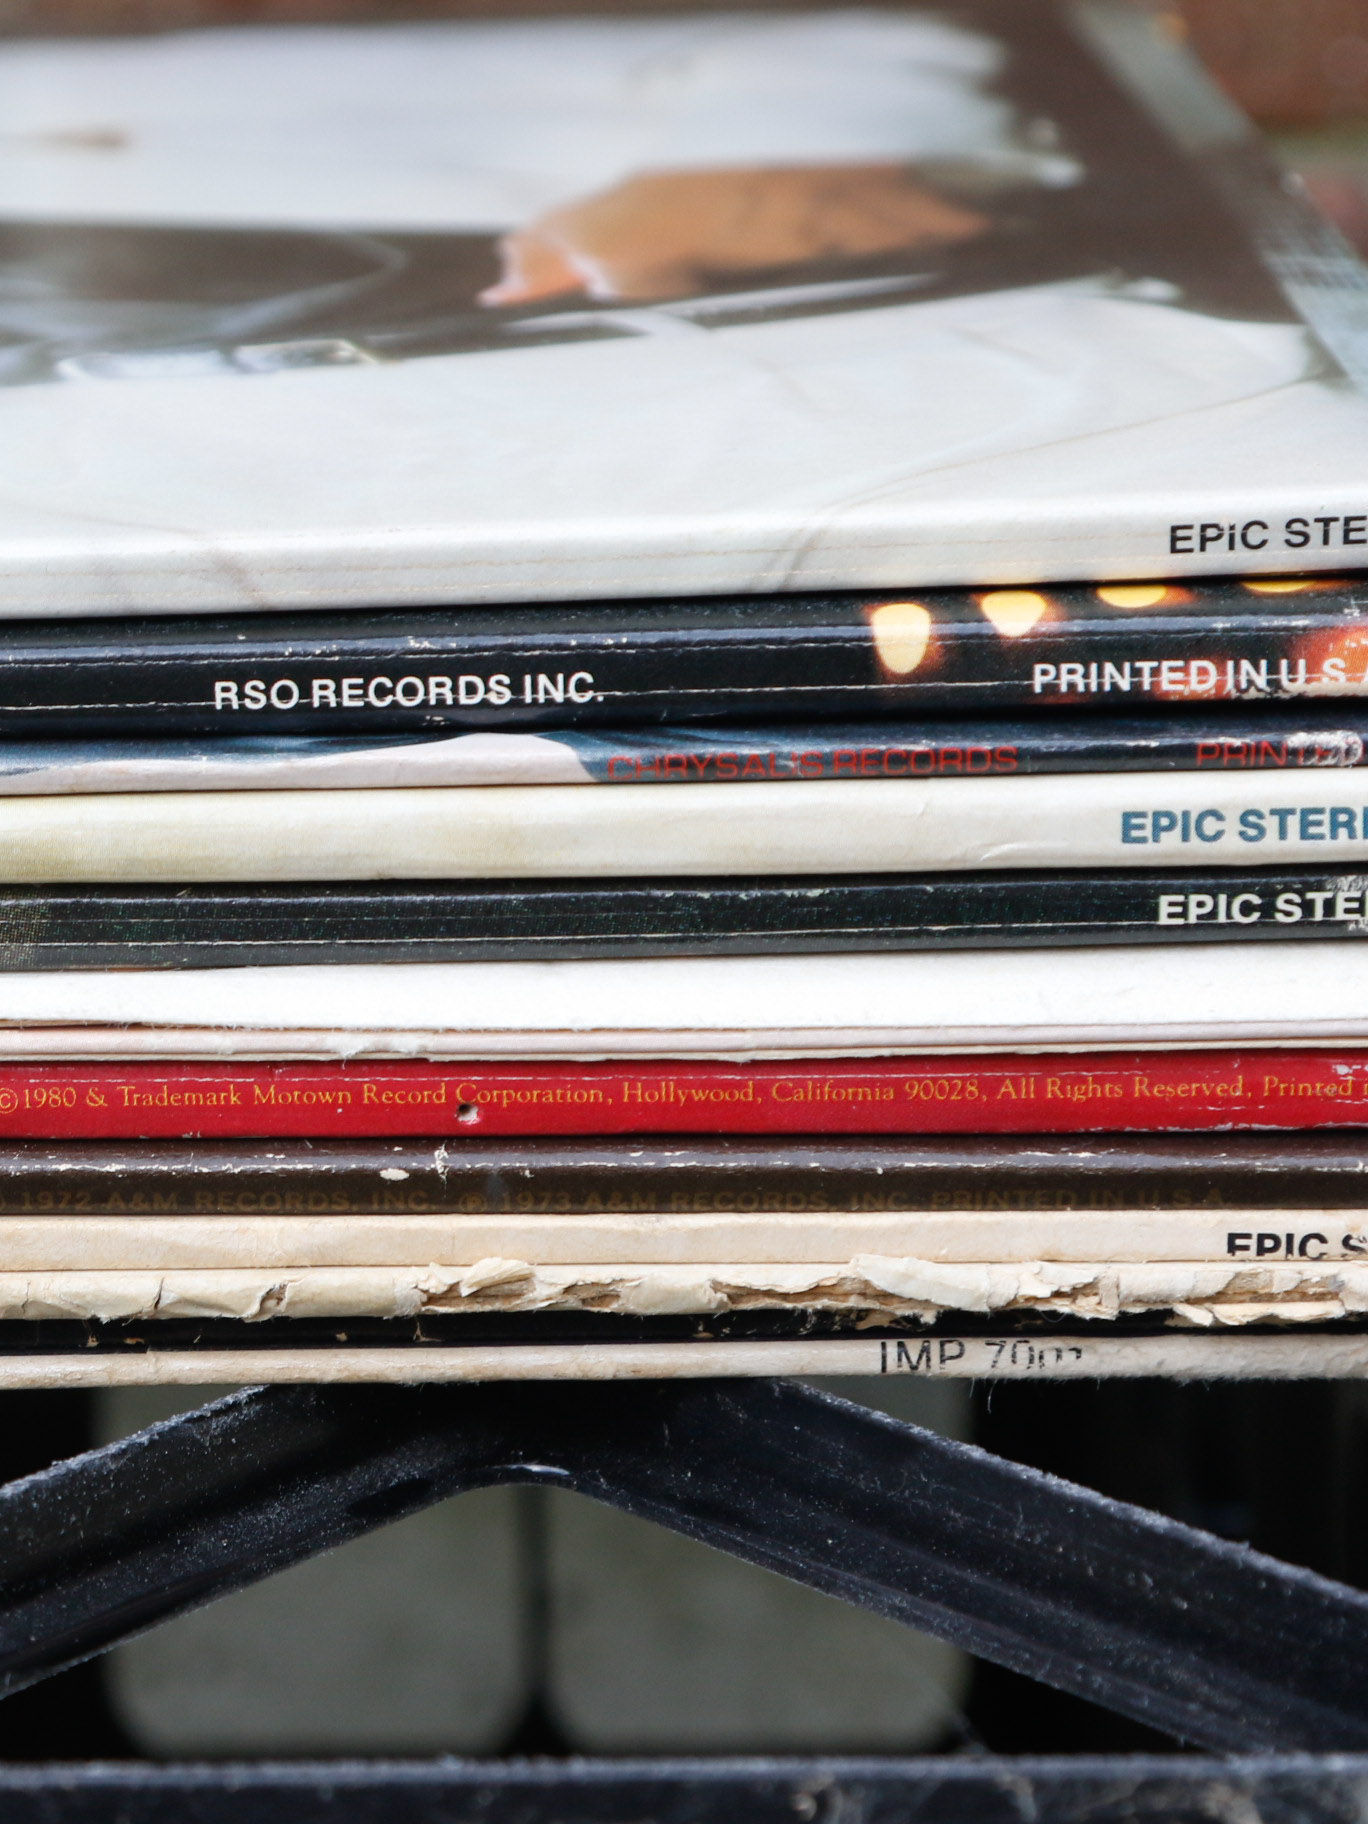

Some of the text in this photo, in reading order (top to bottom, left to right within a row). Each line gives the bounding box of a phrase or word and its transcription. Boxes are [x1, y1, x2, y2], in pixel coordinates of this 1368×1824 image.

[1169, 515, 1368, 554] EPIC STE
[214, 671, 604, 710] RSO RECORDS INC.
[1032, 659, 1219, 694] PRINTED
[1226, 658, 1268, 691] IN
[832, 746, 1019, 776] RECORDS
[1121, 808, 1226, 844] EPIC
[1158, 890, 1368, 925] EPIC STE
[85, 1086, 109, 1107] &
[116, 1084, 242, 1107] Trademark
[253, 1083, 352, 1106] Motown
[363, 1082, 447, 1105] Record
[456, 1081, 613, 1108] Corporation,
[622, 1080, 762, 1107] Hollywood,
[771, 1079, 895, 1102] California
[904, 1078, 987, 1103] 90028,
[996, 1076, 1035, 1100] All
[1045, 1075, 1123, 1102] Rights
[1133, 1075, 1252, 1099] Reserved,
[1263, 1074, 1353, 1097] Printed
[21, 1190, 92, 1212] 1972
[880, 1339, 966, 1374] IMP
